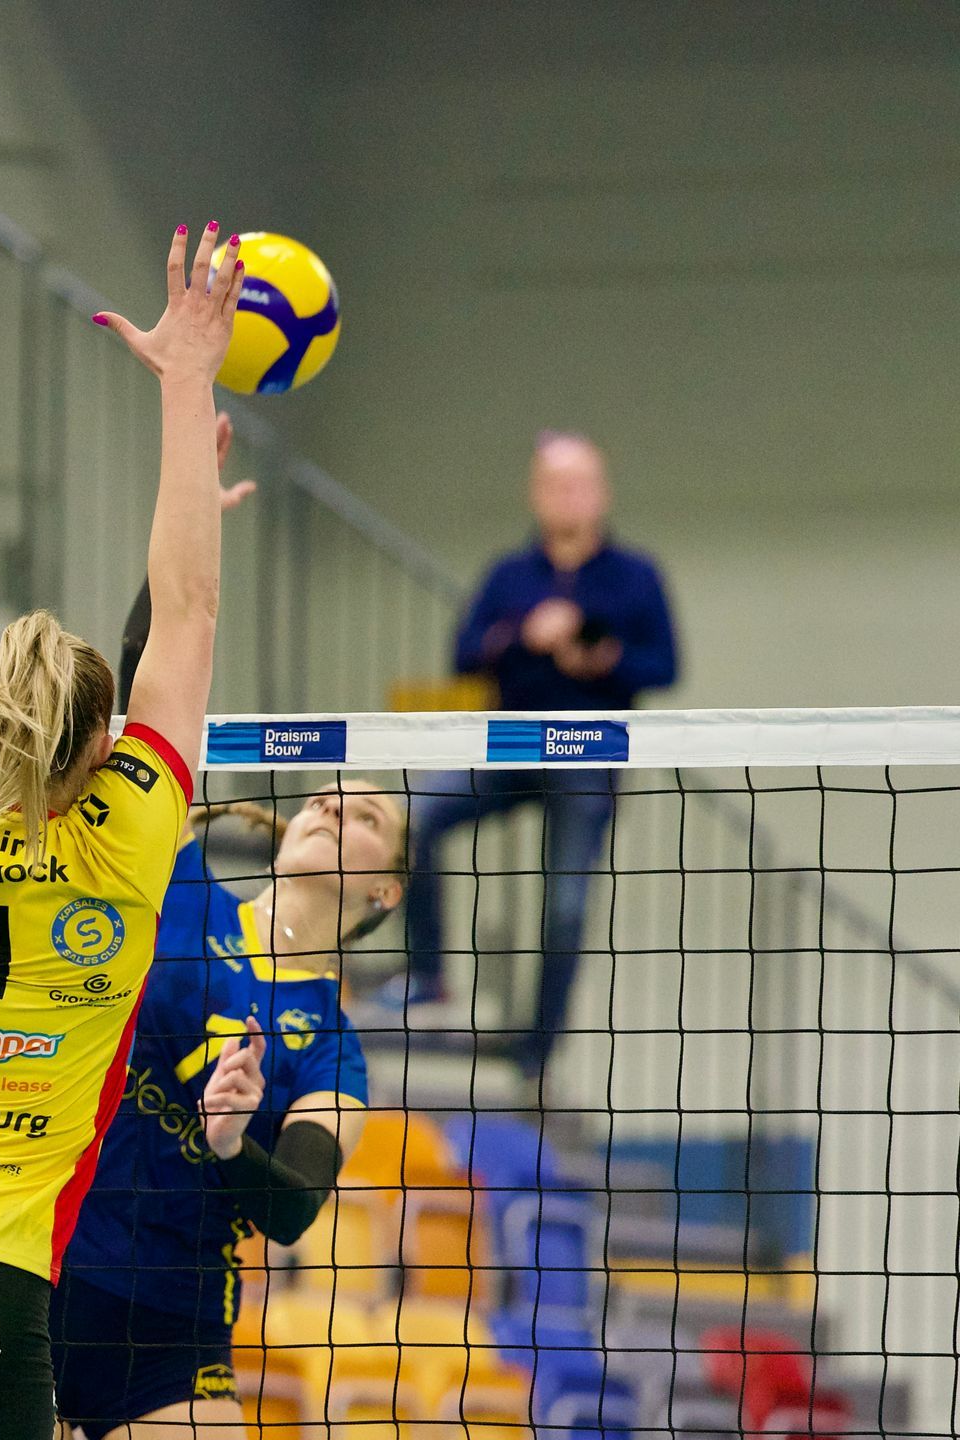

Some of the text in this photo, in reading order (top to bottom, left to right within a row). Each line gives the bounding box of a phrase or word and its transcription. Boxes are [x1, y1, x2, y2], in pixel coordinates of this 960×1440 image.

[265, 728, 320, 742] Draisma
[546, 727, 603, 741] Draisma
[265, 743, 302, 757] Bouw
[545, 742, 585, 755] Bouw
[74, 900, 108, 912] SALES
[62, 936, 122, 964] SALES CLUB
